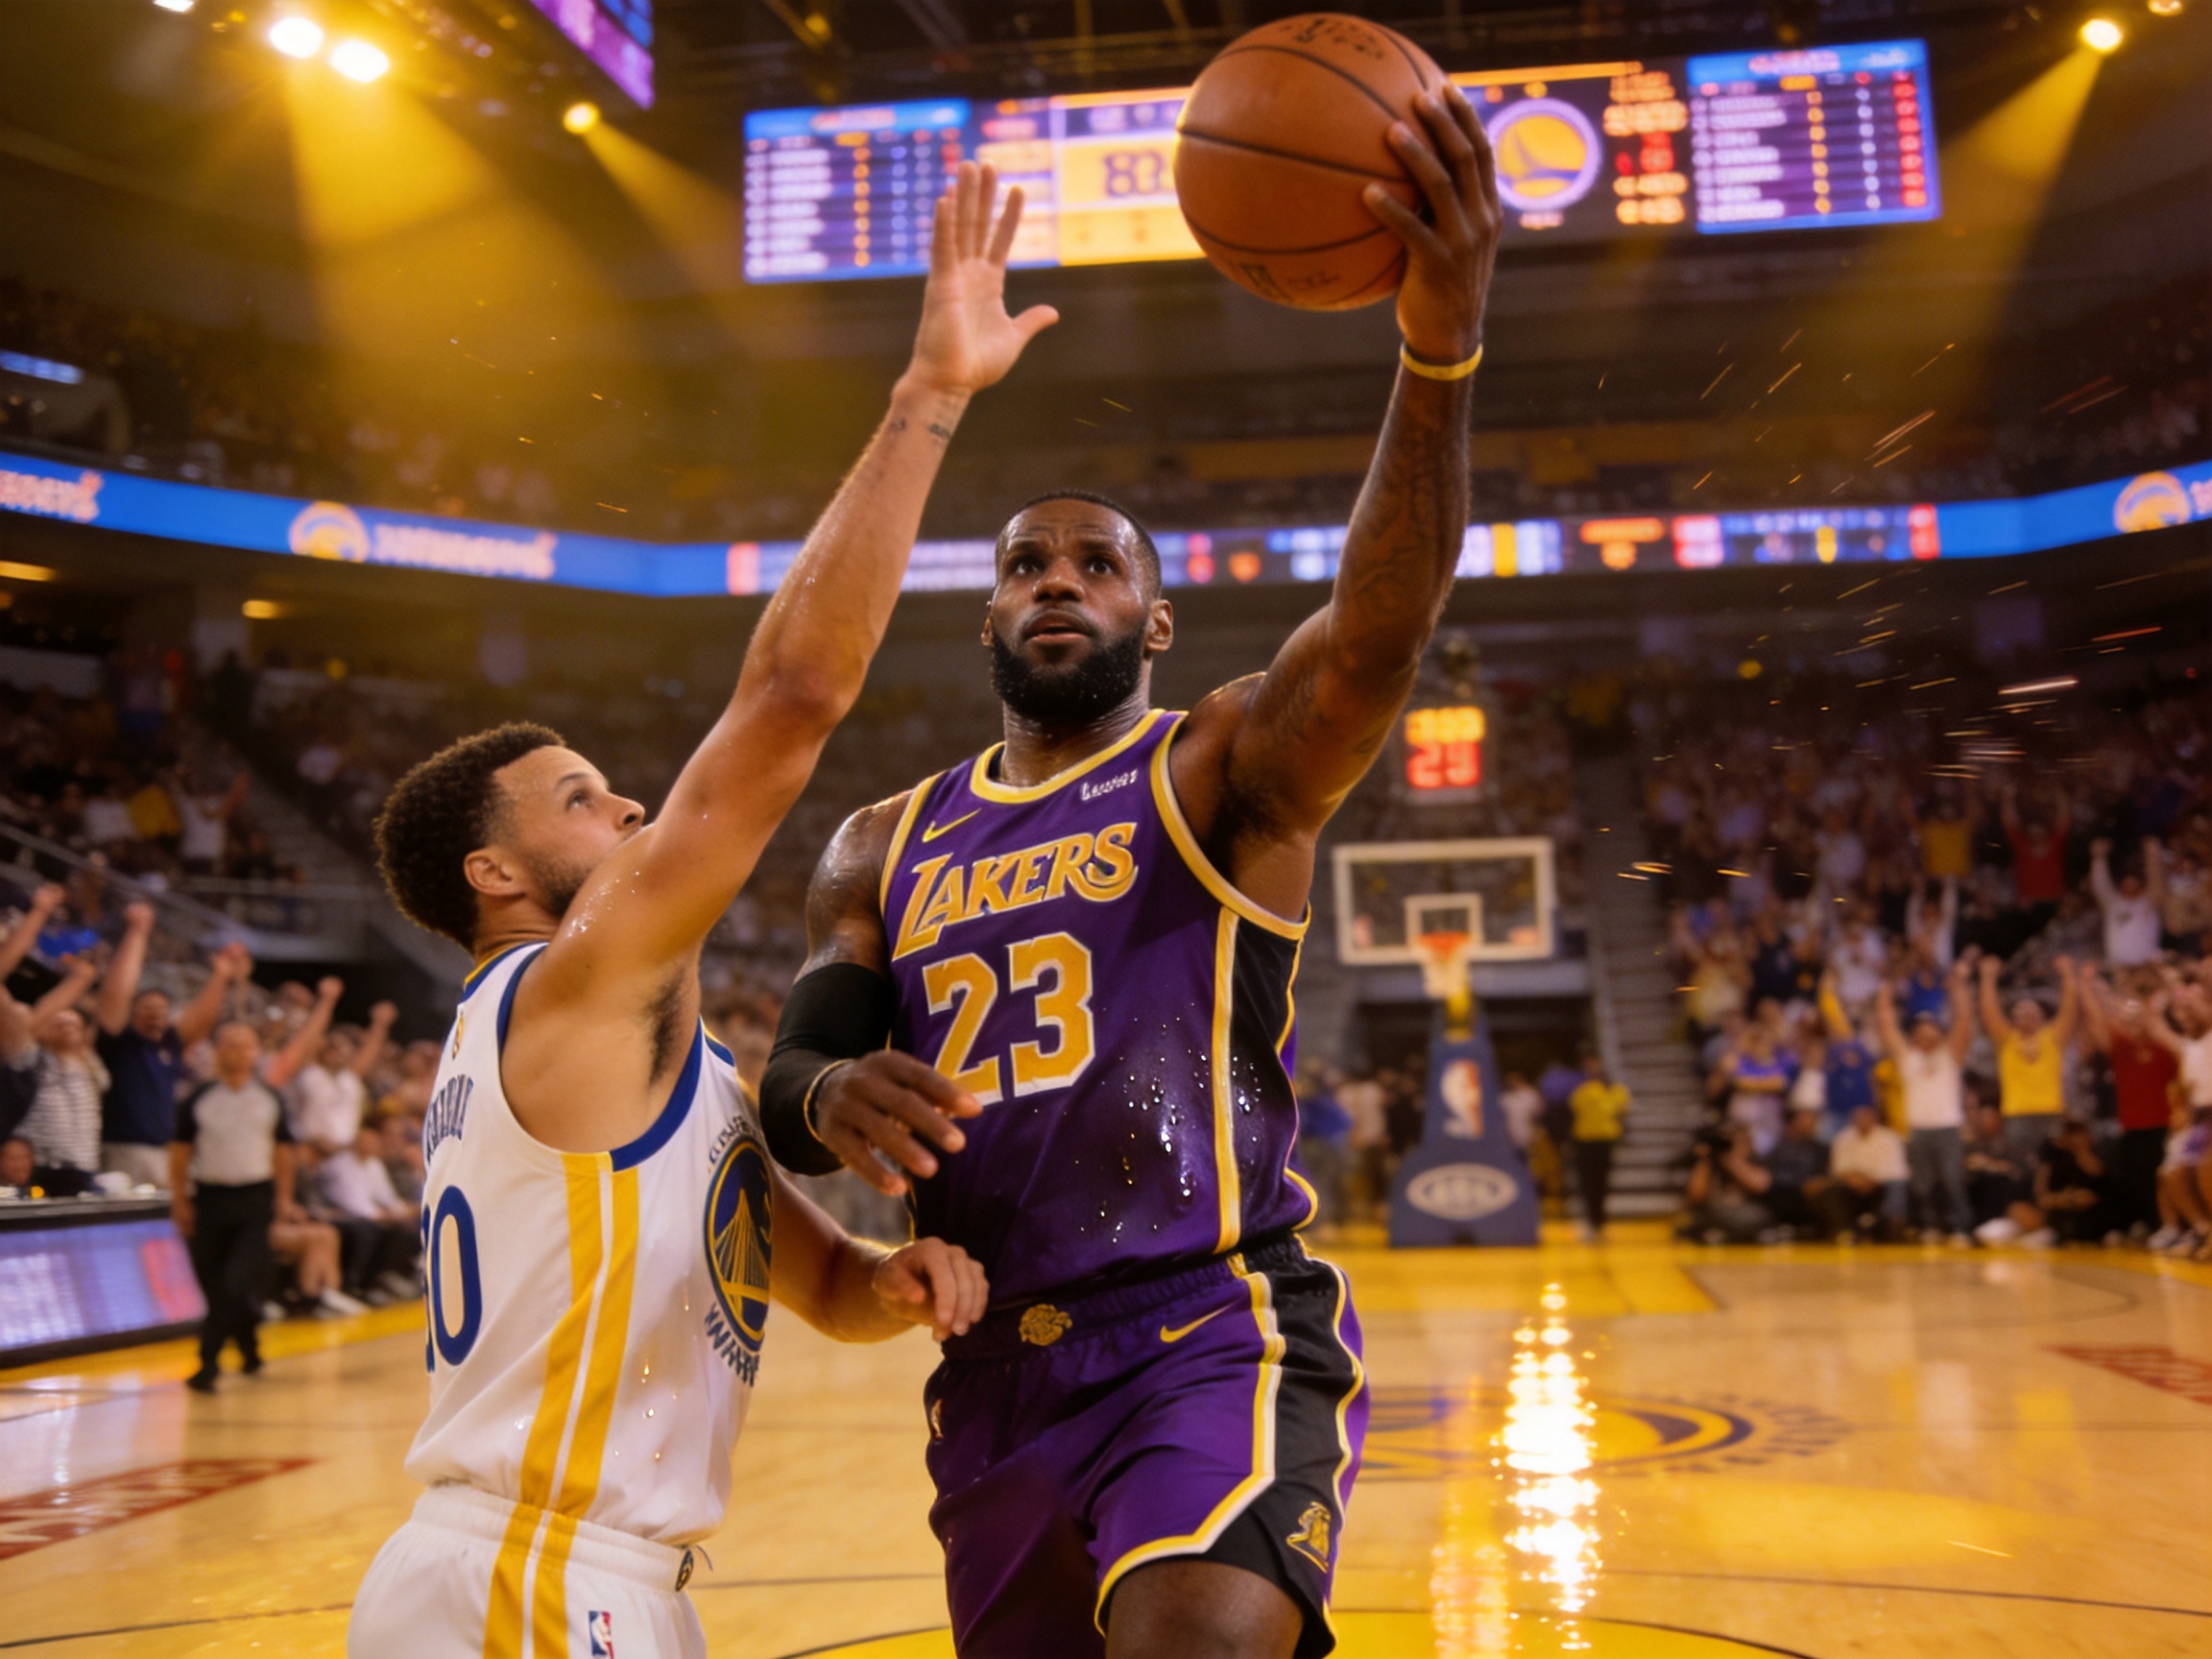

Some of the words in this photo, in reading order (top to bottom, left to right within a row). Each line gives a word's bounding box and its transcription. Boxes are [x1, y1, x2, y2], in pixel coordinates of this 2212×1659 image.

[891, 822, 1138, 962] LAKERS
[922, 930, 1096, 1106] 23
[421, 1184, 483, 1374] 0
